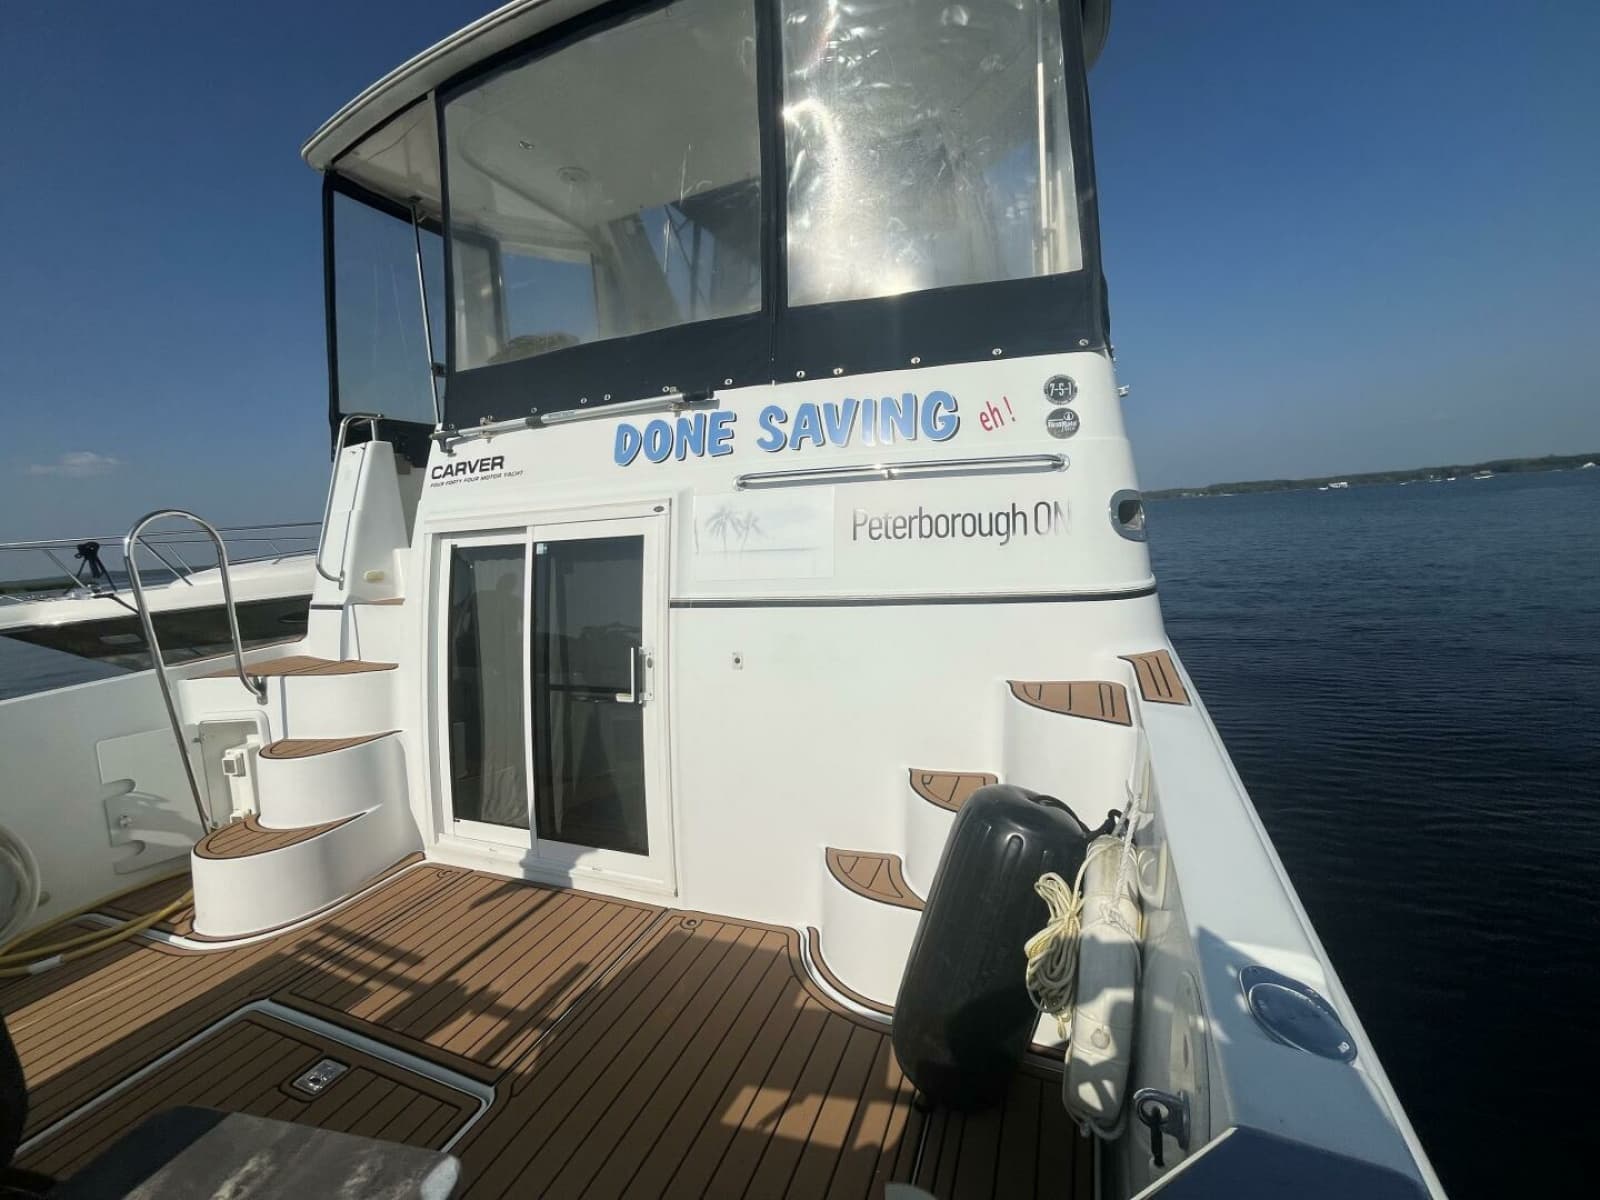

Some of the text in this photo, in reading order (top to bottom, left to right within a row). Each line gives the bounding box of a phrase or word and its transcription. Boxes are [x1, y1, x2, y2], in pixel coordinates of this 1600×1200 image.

[614, 390, 960, 466] DONE SAVING
[431, 455, 504, 479] CARVER
[852, 502, 1028, 546] Peterborough
